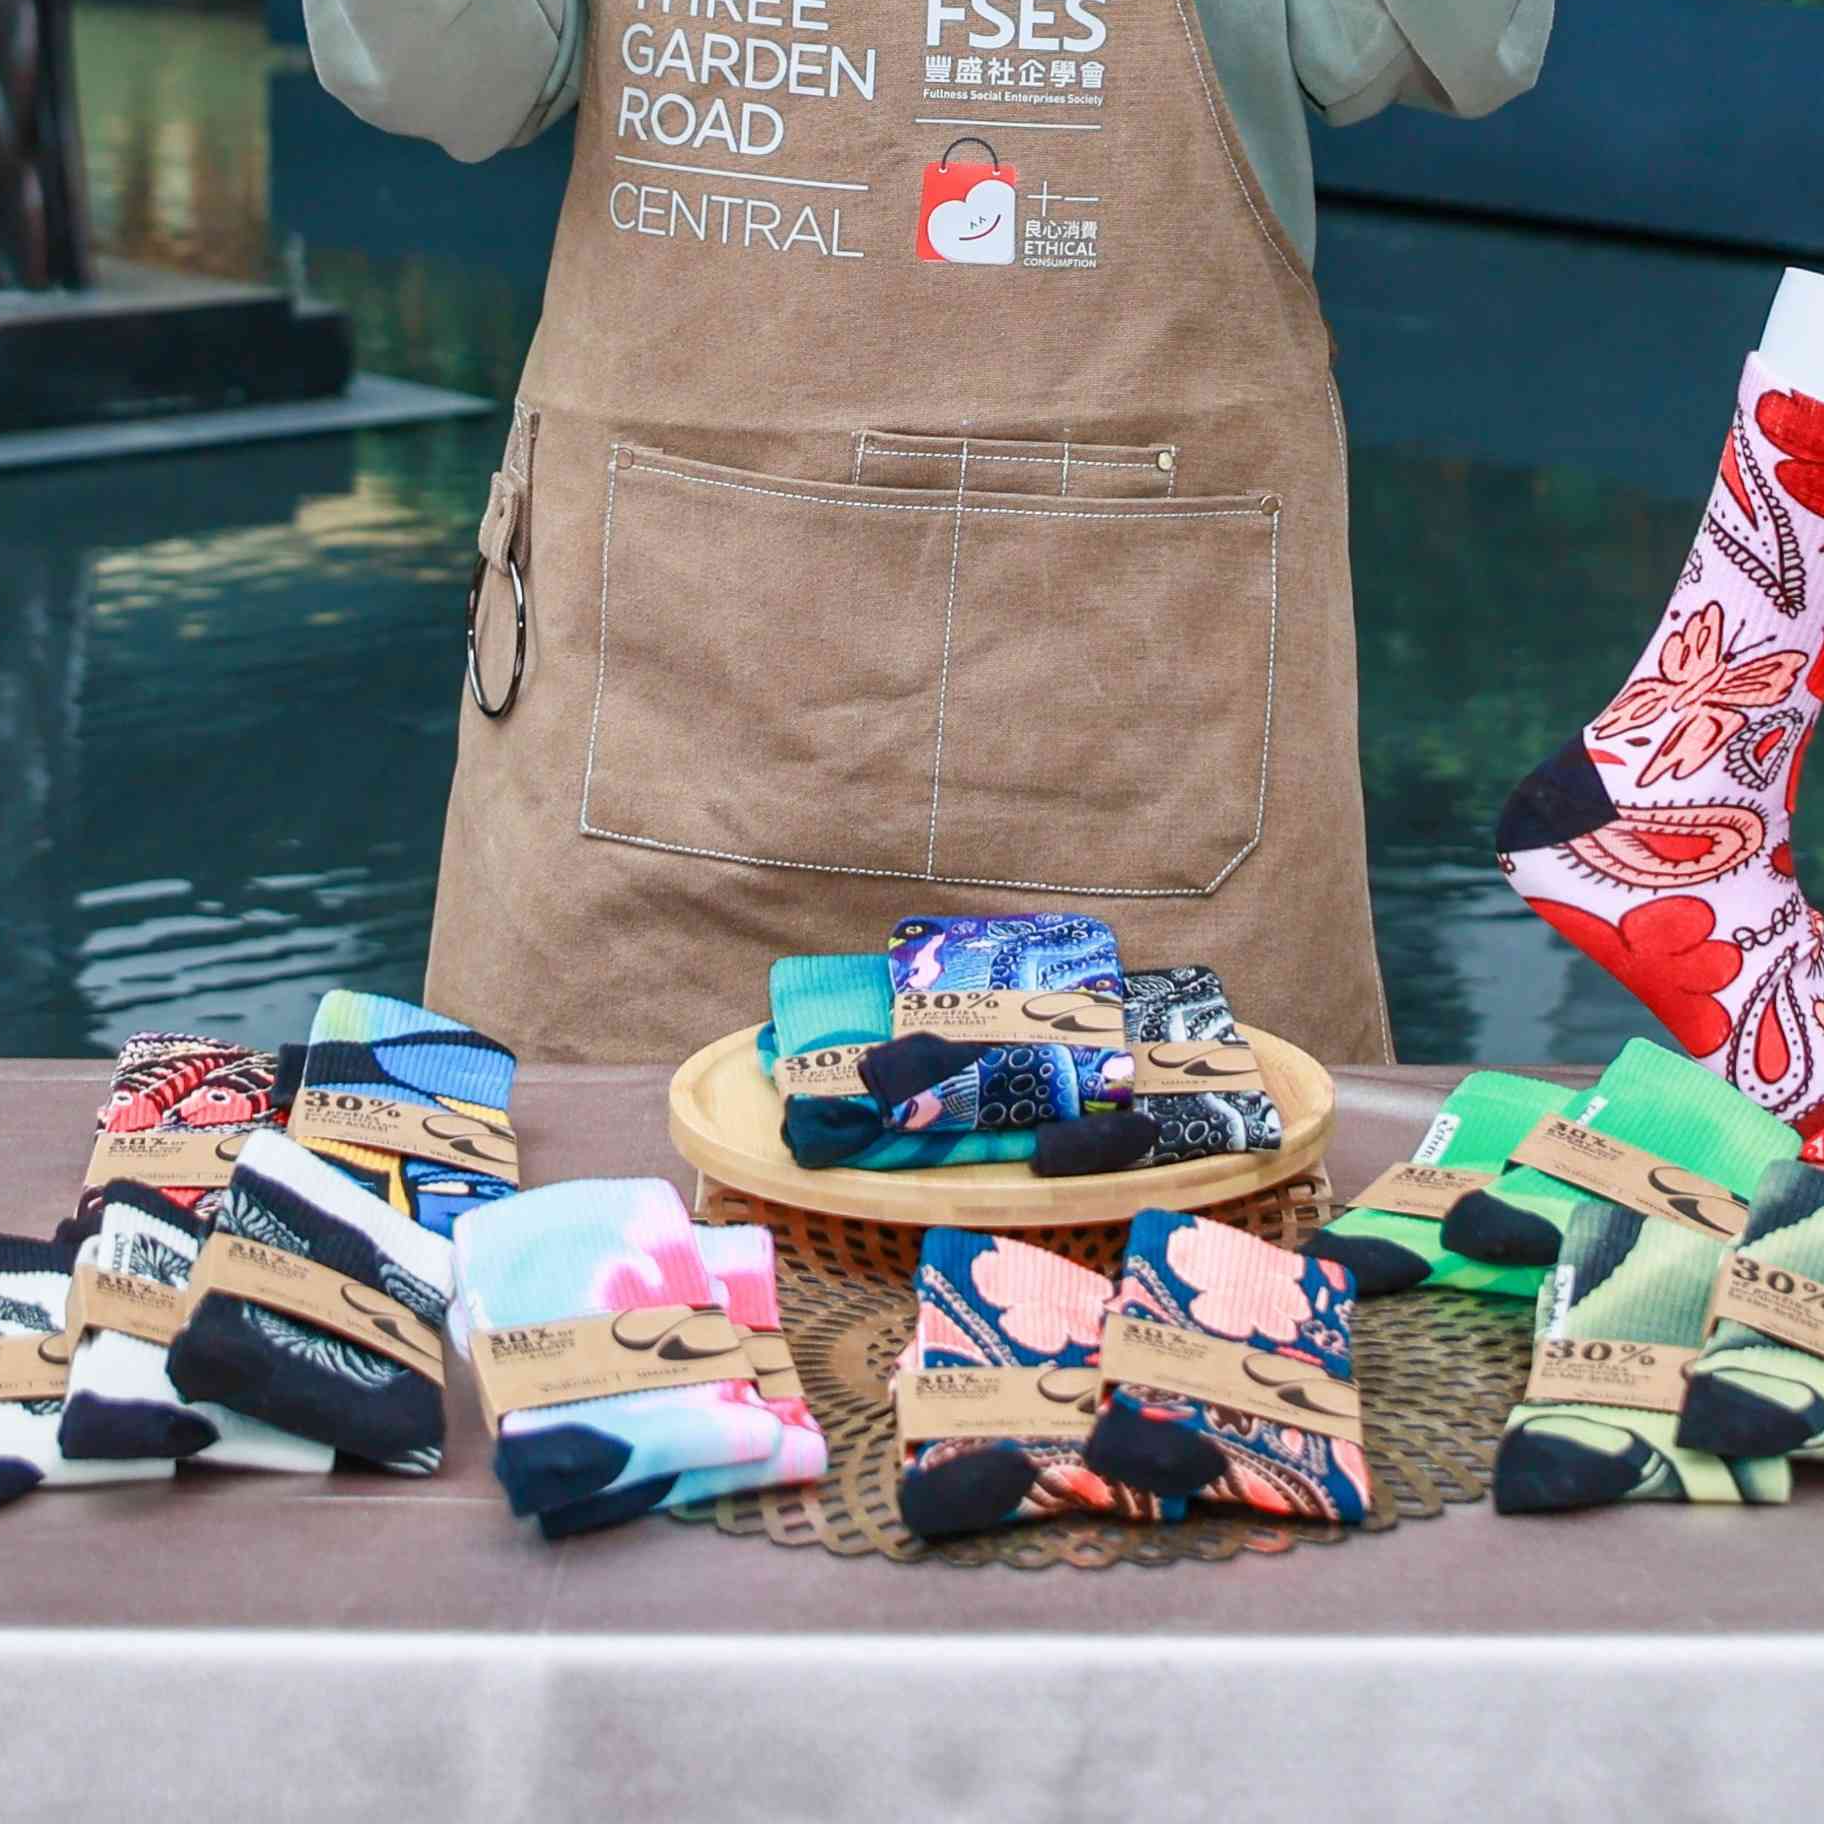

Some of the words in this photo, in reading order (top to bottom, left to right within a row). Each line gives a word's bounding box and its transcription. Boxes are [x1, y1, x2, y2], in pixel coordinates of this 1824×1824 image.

[621, 23, 875, 101] GARDEN
[924, 54, 1105, 89] 豐盛社企學會
[923, 88, 968, 101] Fullness
[970, 90, 1003, 102] Social
[1004, 92, 1066, 104] Enterprises
[1067, 93, 1104, 106] Society
[618, 86, 784, 155] ROAD
[610, 181, 864, 258] CENTRAL
[1025, 220, 1098, 240] 良心消費
[1023, 257, 1097, 268] CONSUMPTION
[1024, 241, 1097, 257] ETHICAL
[901, 992, 999, 1010] 30%
[304, 1090, 401, 1118] 30%
[1545, 1338, 1656, 1366] 30%
